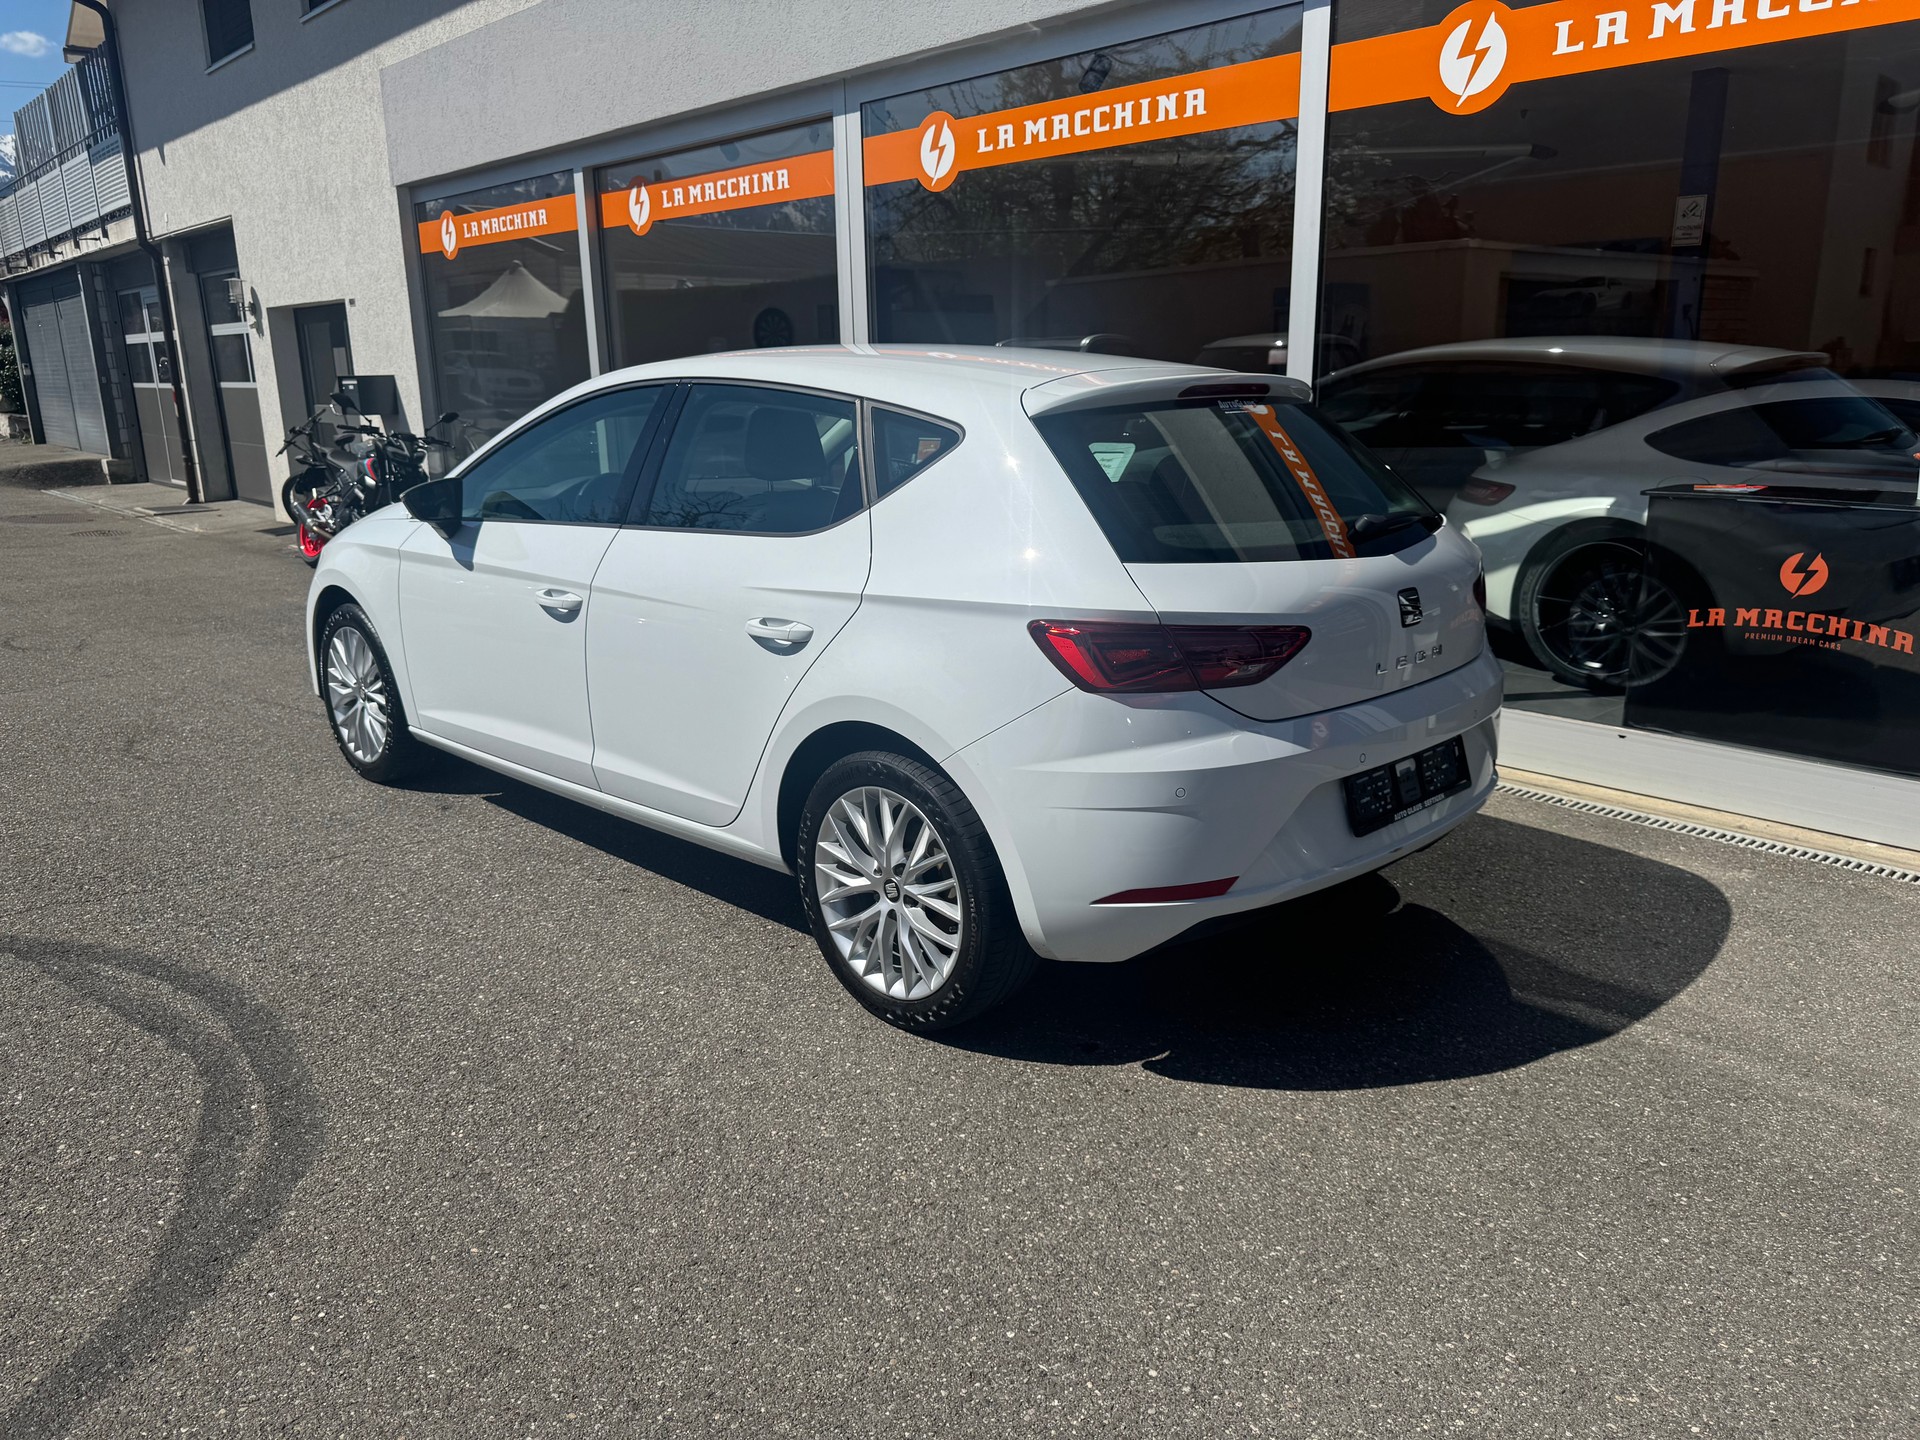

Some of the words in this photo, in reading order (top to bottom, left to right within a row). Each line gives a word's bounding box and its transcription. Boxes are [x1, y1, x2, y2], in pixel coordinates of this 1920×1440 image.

[1551, 11, 1630, 56] LA
[1647, 0, 1879, 39] MAC
[977, 123, 1015, 153] LA
[1023, 88, 1207, 145] MACCHINA
[662, 189, 685, 208] LA
[688, 168, 791, 203] MACCHINA
[463, 222, 480, 238] LA
[480, 208, 548, 233] MACCHINA
[1687, 608, 1726, 628] LA
[1734, 607, 1914, 655] MACCHINA
[1744, 632, 1783, 642] PREMIUM
[1786, 635, 1816, 646] DREAM
[1818, 640, 1842, 651] CARS
[1376, 644, 1442, 675] LEON
